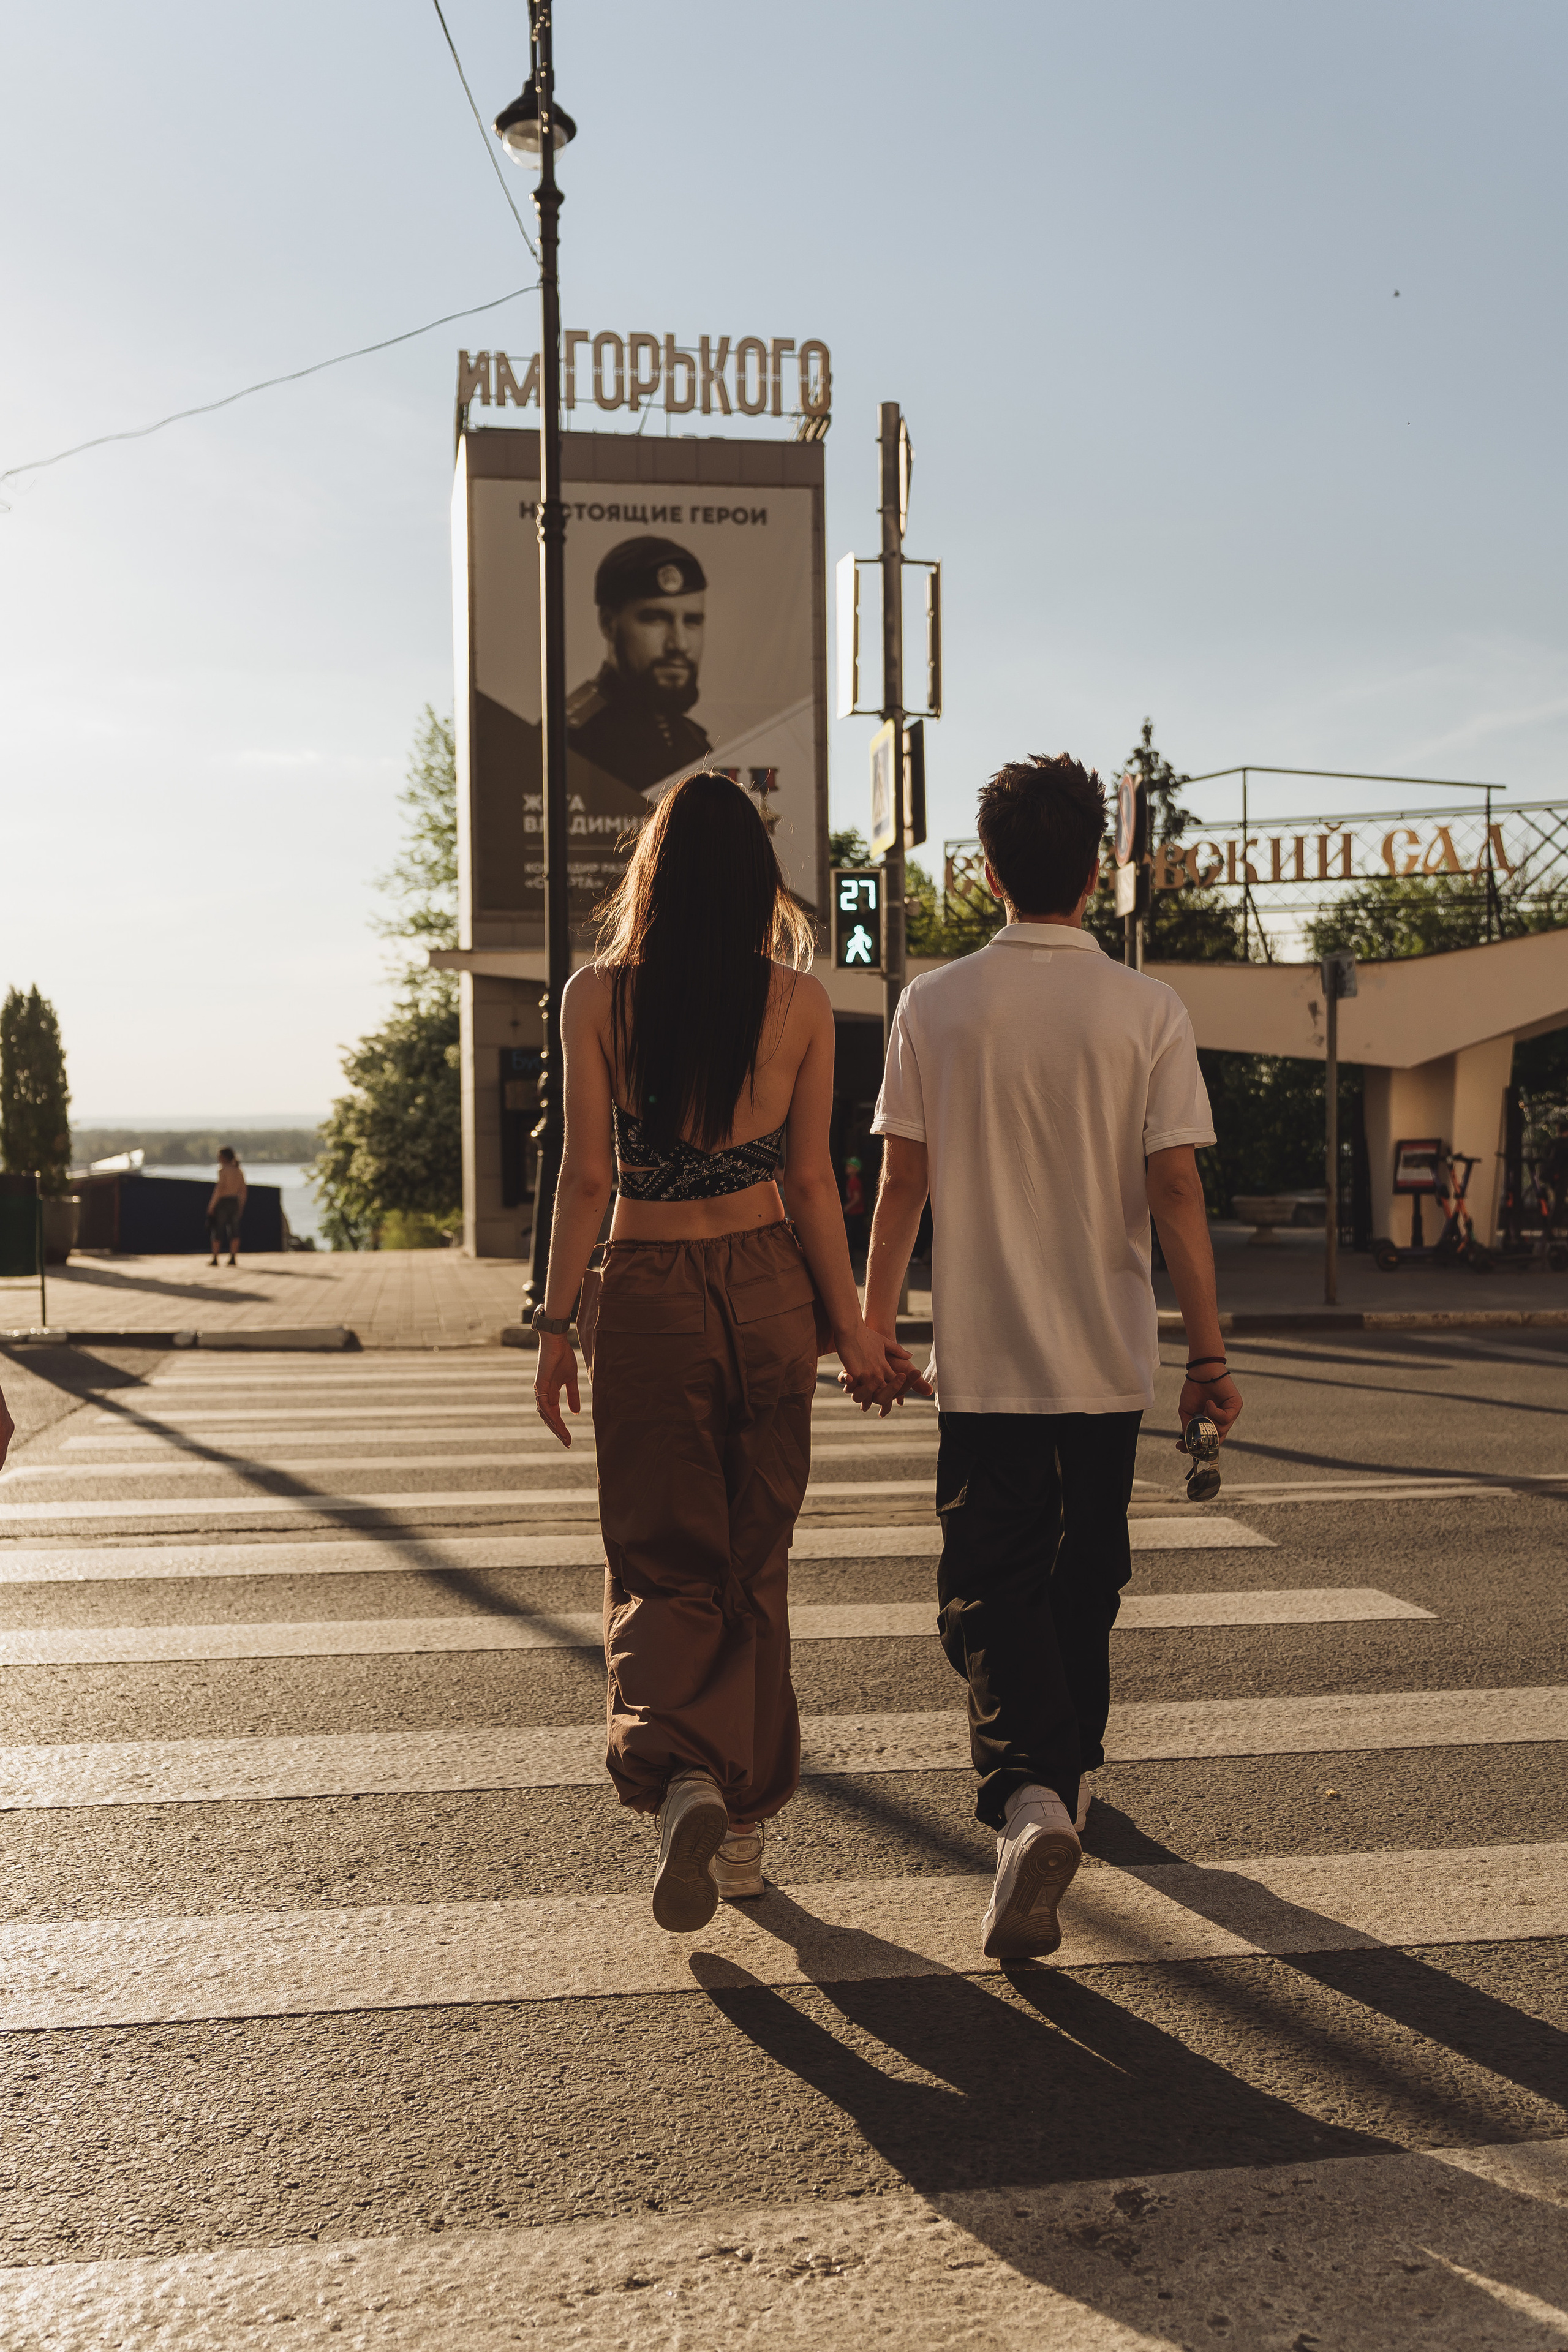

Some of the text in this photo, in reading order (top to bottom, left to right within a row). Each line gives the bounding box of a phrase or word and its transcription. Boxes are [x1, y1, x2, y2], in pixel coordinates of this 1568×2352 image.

[565, 330, 831, 416] ГОРЬКОГО
[519, 501, 767, 526] НСТОЯЩИЕ ГЕРОИ
[1382, 823, 1518, 882] САД
[840, 880, 876, 911] 27
